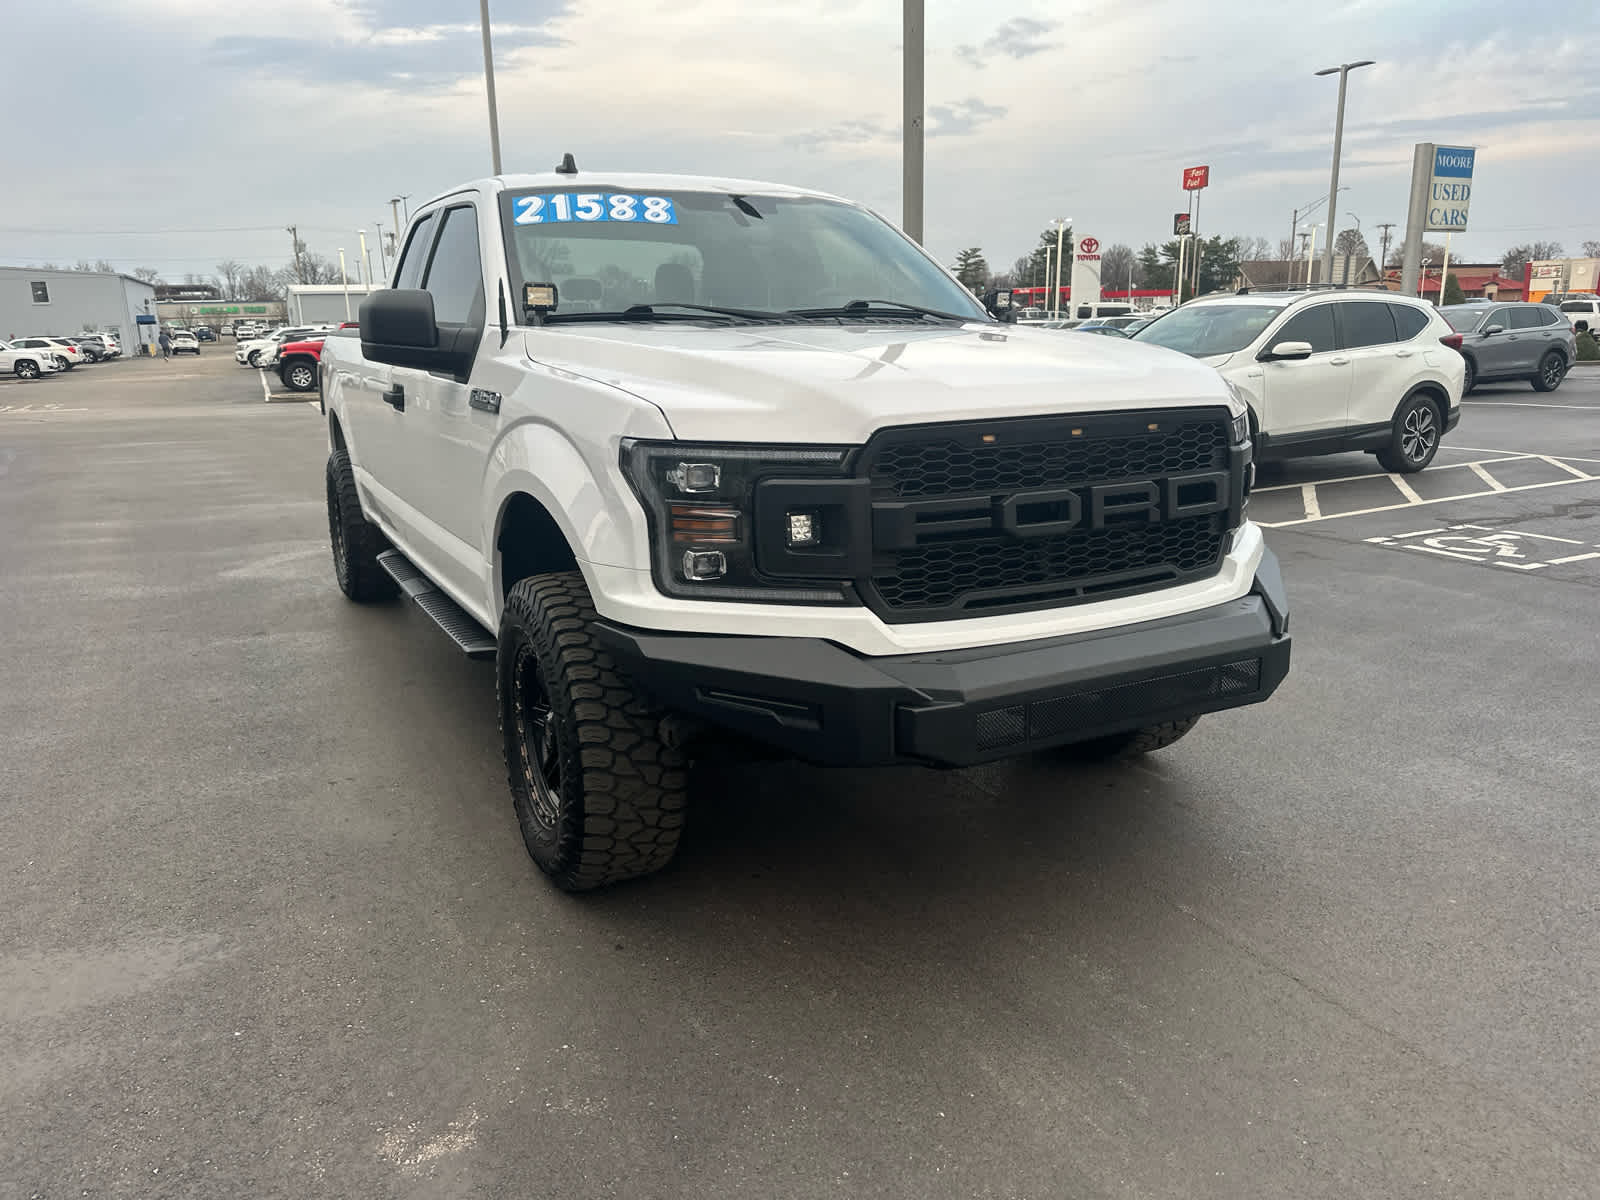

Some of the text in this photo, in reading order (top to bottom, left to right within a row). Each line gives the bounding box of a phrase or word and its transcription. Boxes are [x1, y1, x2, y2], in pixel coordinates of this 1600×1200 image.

[1437, 155, 1473, 168] MOORE
[1191, 168, 1205, 177] Fast
[1186, 177, 1200, 187] Fuel
[1432, 183, 1471, 201] USED
[515, 193, 672, 224] 21588
[1429, 207, 1468, 226] CARS
[903, 471, 1228, 549] FORD
